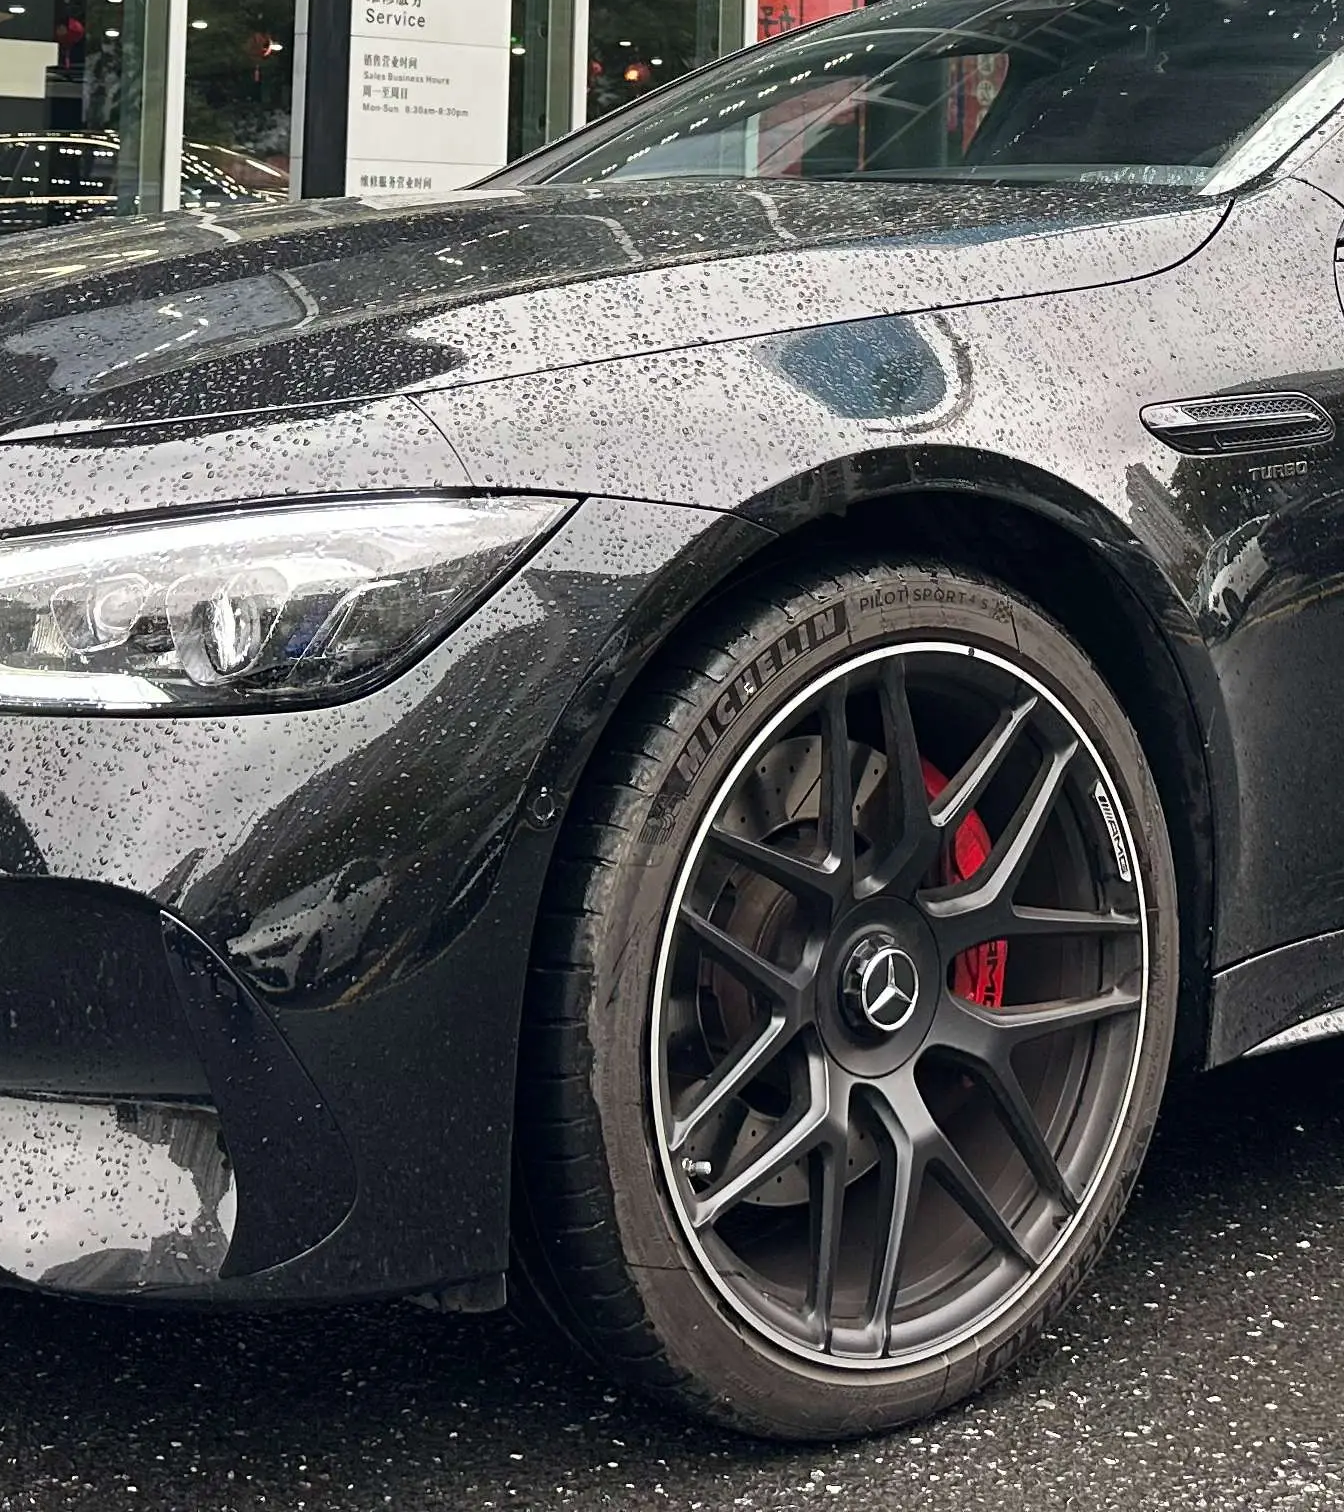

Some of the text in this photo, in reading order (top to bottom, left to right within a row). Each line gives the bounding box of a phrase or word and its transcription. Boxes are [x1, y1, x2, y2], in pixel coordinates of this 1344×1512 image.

[365, 8, 426, 28] Service
[363, 71, 450, 85] Sales Business Hours
[1248, 460, 1308, 481] TURBO
[859, 589, 906, 612] PILOT
[912, 587, 967, 604] SPORT
[674, 608, 838, 785] MICHELIN
